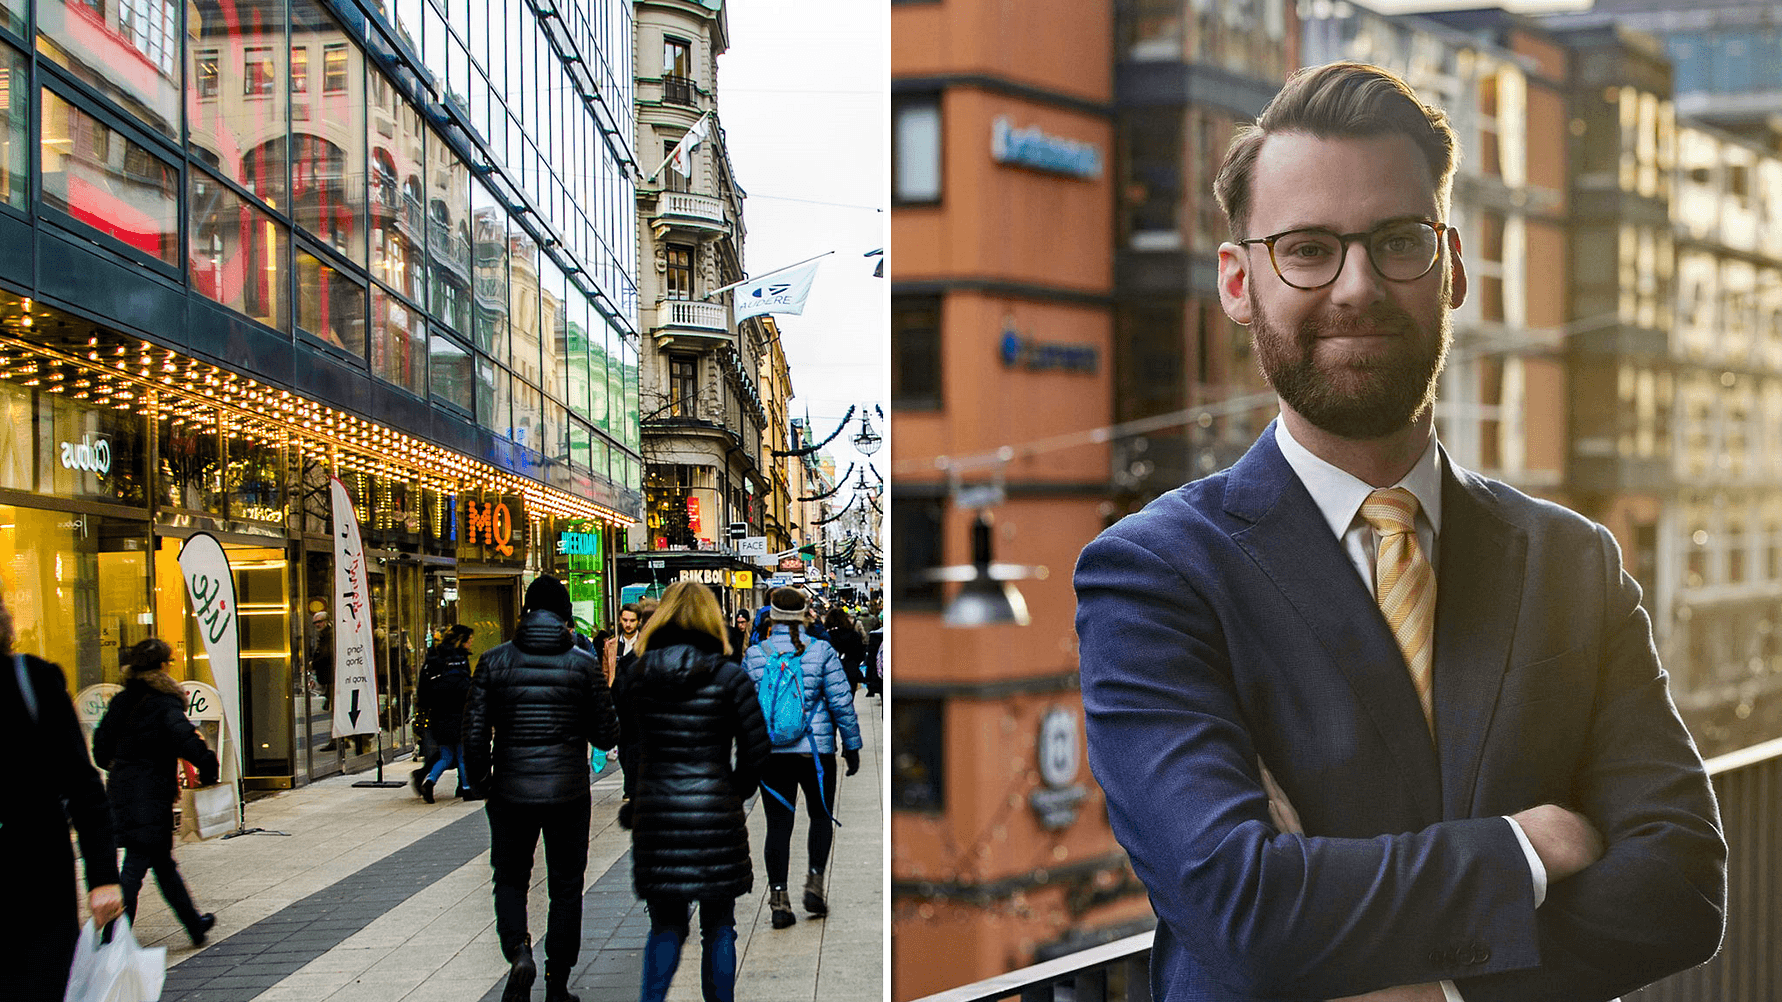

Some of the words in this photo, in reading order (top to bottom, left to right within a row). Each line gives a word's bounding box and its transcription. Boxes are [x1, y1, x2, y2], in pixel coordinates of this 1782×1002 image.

[740, 295, 792, 311] AUDERE
[469, 500, 514, 556] MQ
[561, 531, 597, 555] WEEKDAY
[742, 541, 763, 550] FACE
